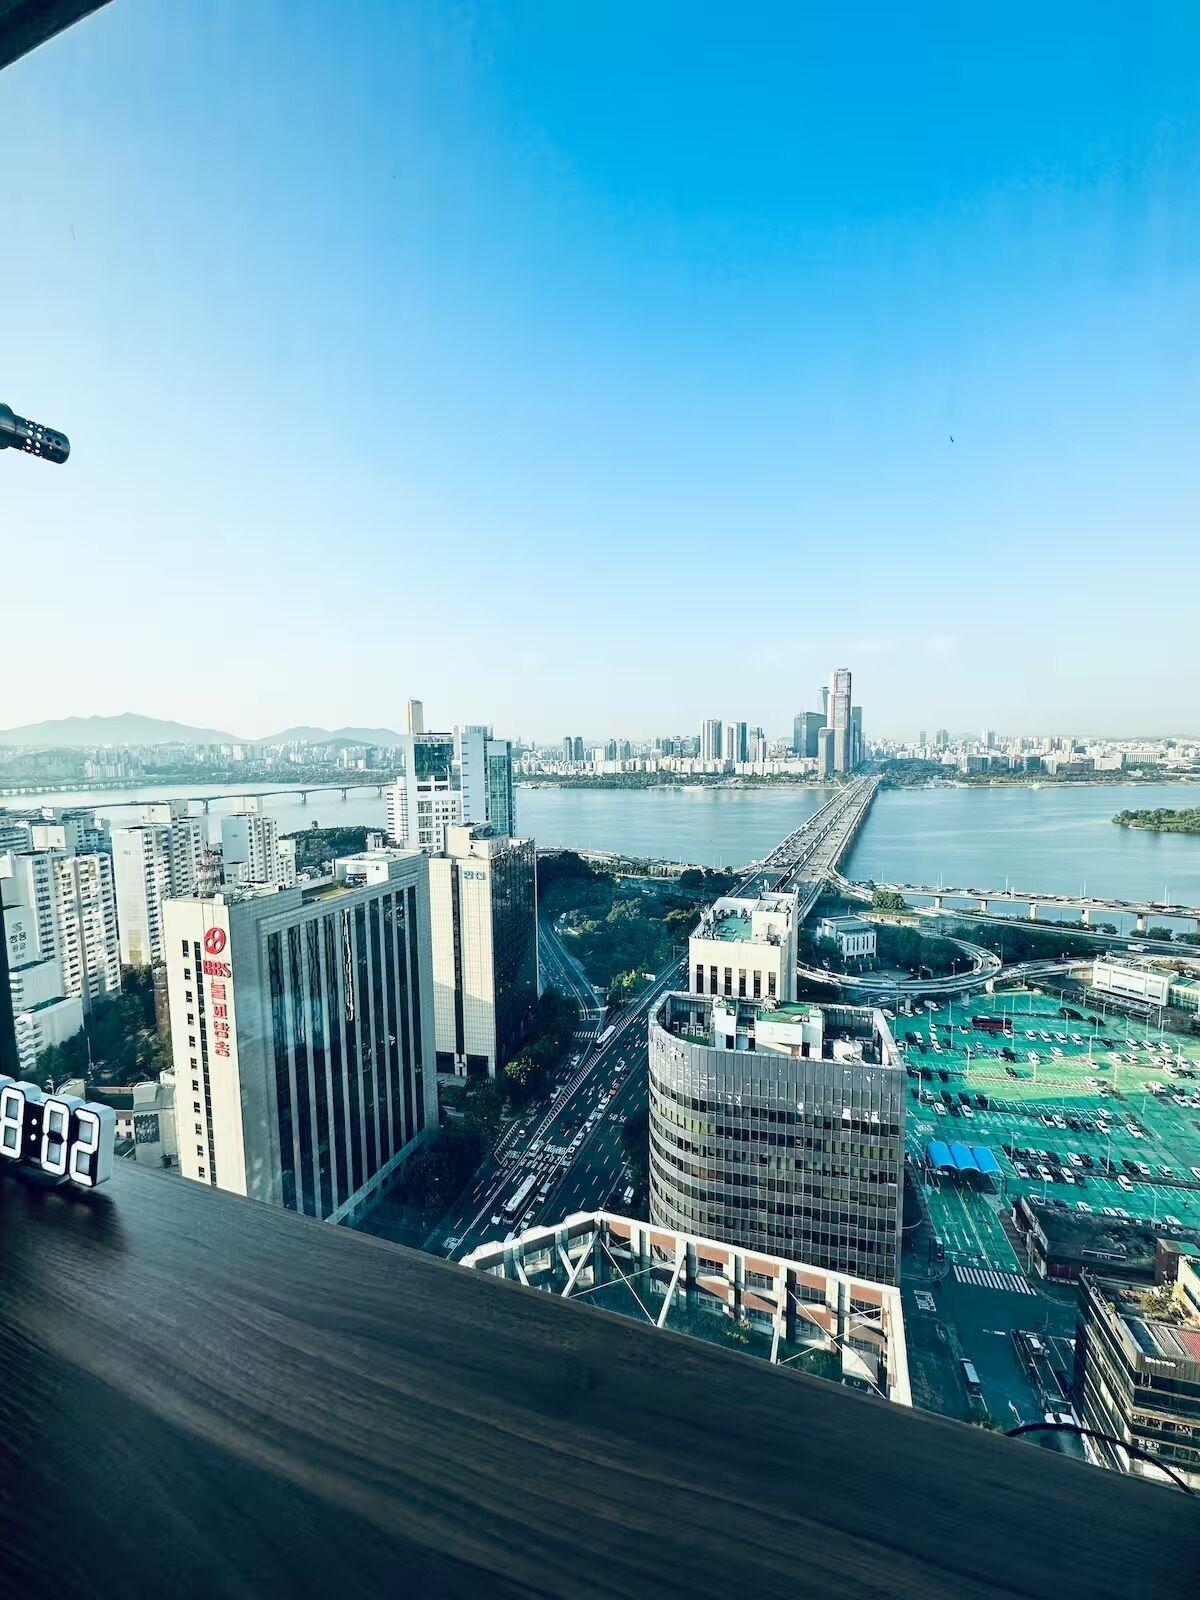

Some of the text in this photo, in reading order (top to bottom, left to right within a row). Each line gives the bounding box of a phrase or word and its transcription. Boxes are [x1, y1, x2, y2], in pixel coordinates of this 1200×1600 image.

[203, 960, 232, 979] BBS
[608, 1113, 618, 1121] 50
[0, 1086, 100, 1187] 8:02
